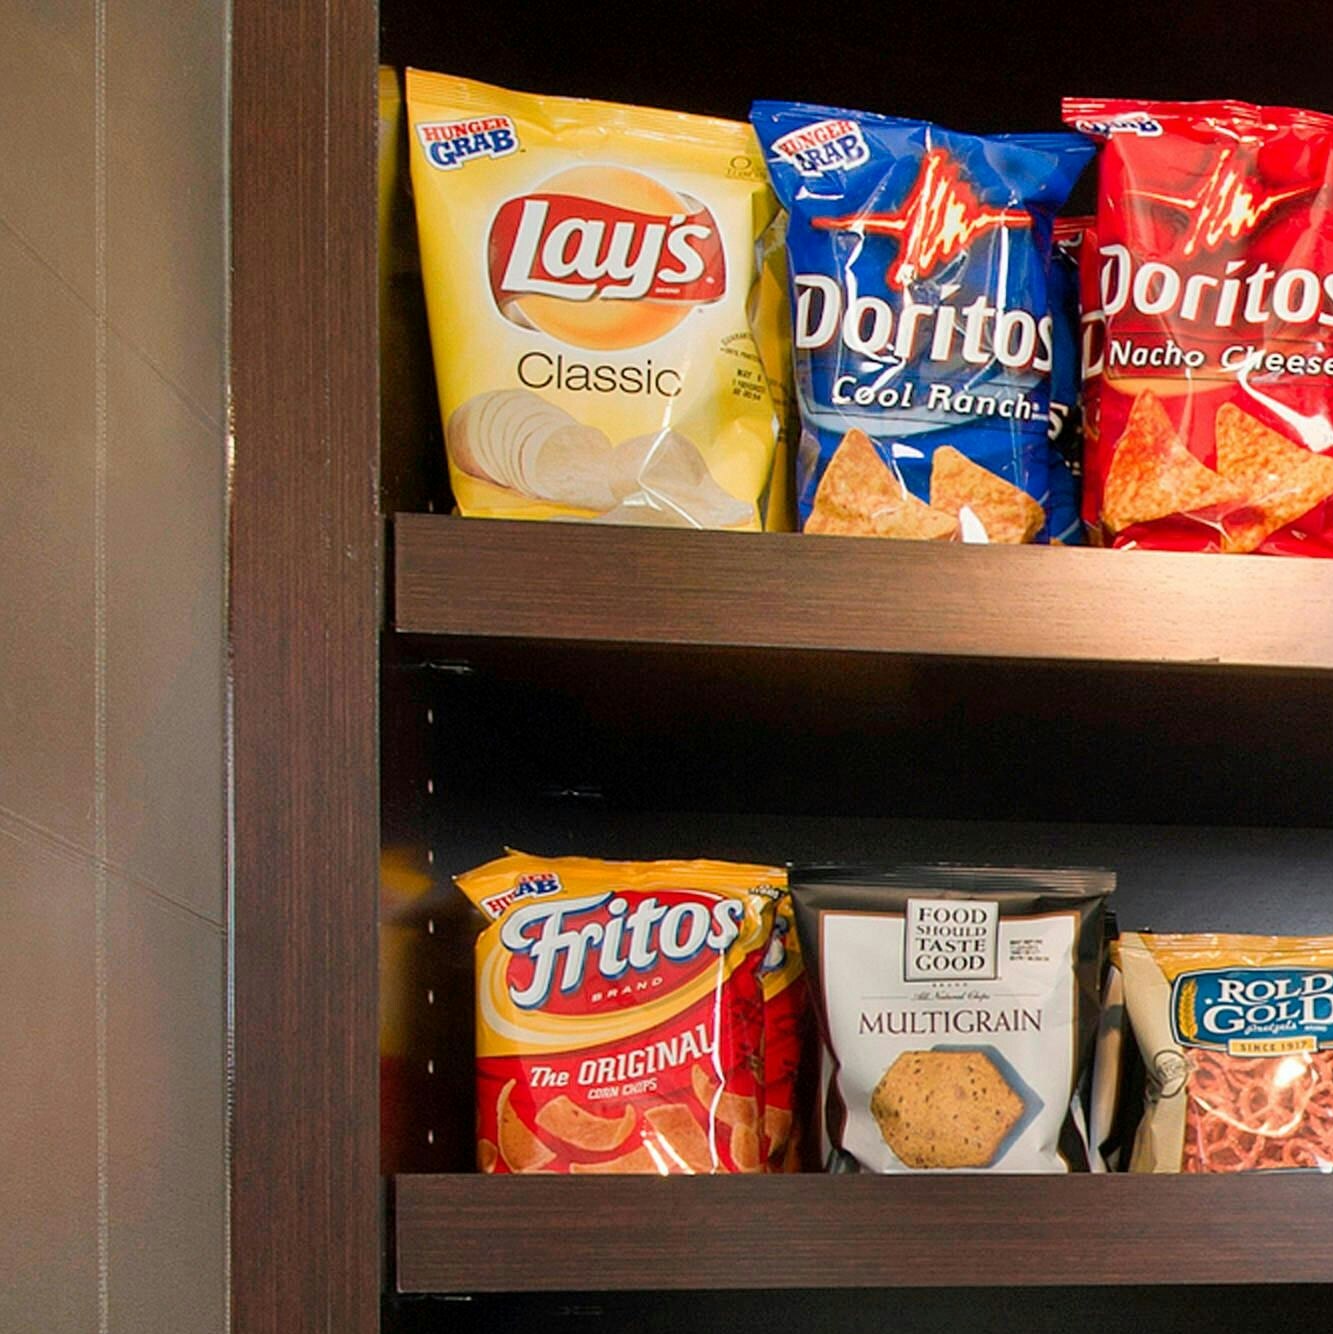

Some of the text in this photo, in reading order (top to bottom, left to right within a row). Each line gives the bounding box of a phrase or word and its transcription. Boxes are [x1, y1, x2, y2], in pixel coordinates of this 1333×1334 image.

[423, 118, 509, 141] HUNGER
[430, 129, 515, 166] GRAB
[500, 198, 712, 301] Lay's
[794, 274, 1052, 373] Doritos
[1109, 340, 1205, 369] Nacho
[517, 351, 683, 399] Classic
[831, 375, 1033, 420] Cool Ranch
[918, 907, 989, 924] FOOD
[917, 925, 987, 938] SHOULD
[501, 892, 744, 1010] Fritos
[915, 938, 987, 954] TASTE
[915, 955, 986, 972] GOOD
[592, 976, 664, 1003] BRAND
[859, 1009, 1042, 1035] MULTIGRAIN
[530, 1025, 716, 1088] The ORIGINAL
[588, 1078, 658, 1100] CORN CHIPS
